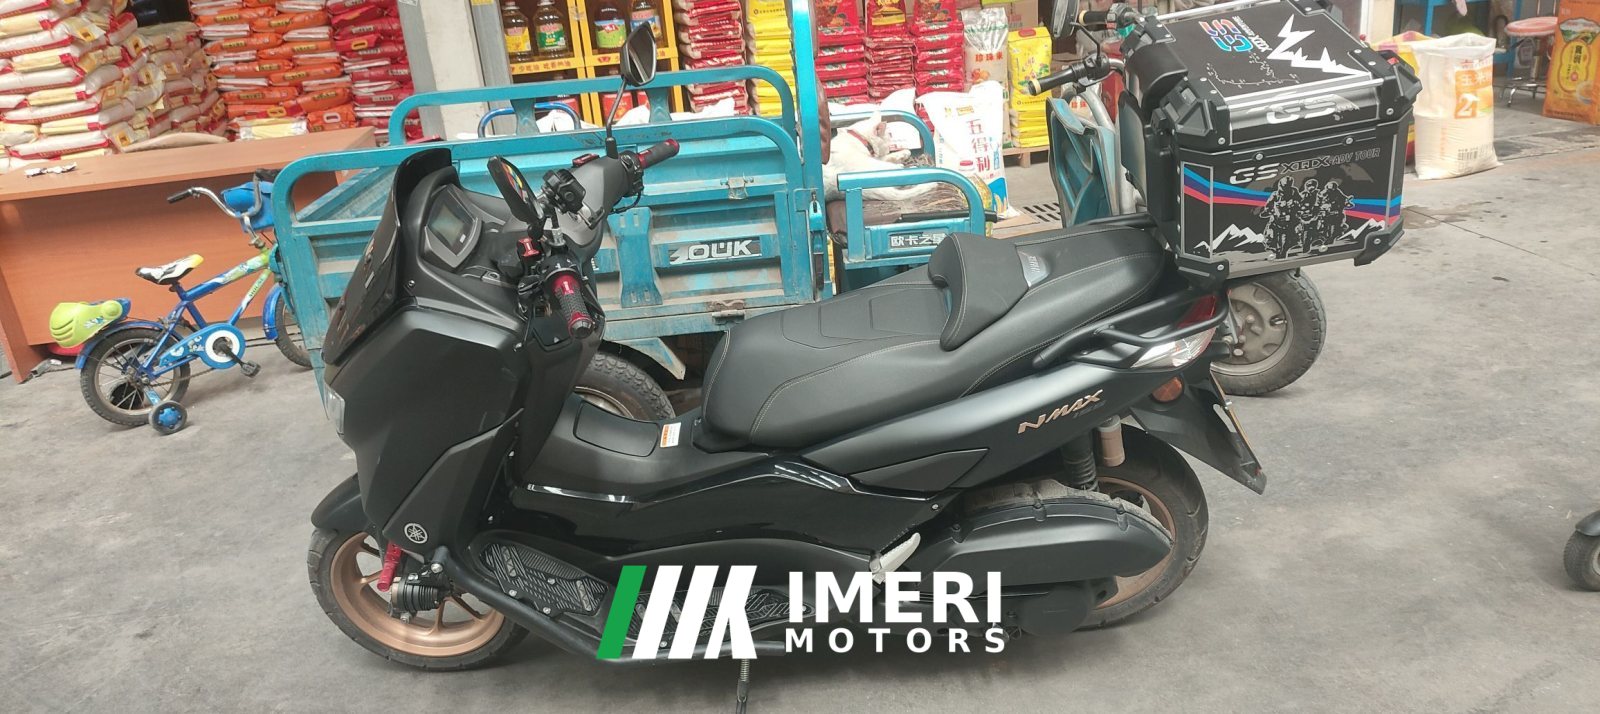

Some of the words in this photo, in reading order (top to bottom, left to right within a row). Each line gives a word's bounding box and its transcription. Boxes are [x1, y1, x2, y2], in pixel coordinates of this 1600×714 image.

[966, 119, 991, 172] 五得利
[1018, 389, 1103, 433] NMAX
